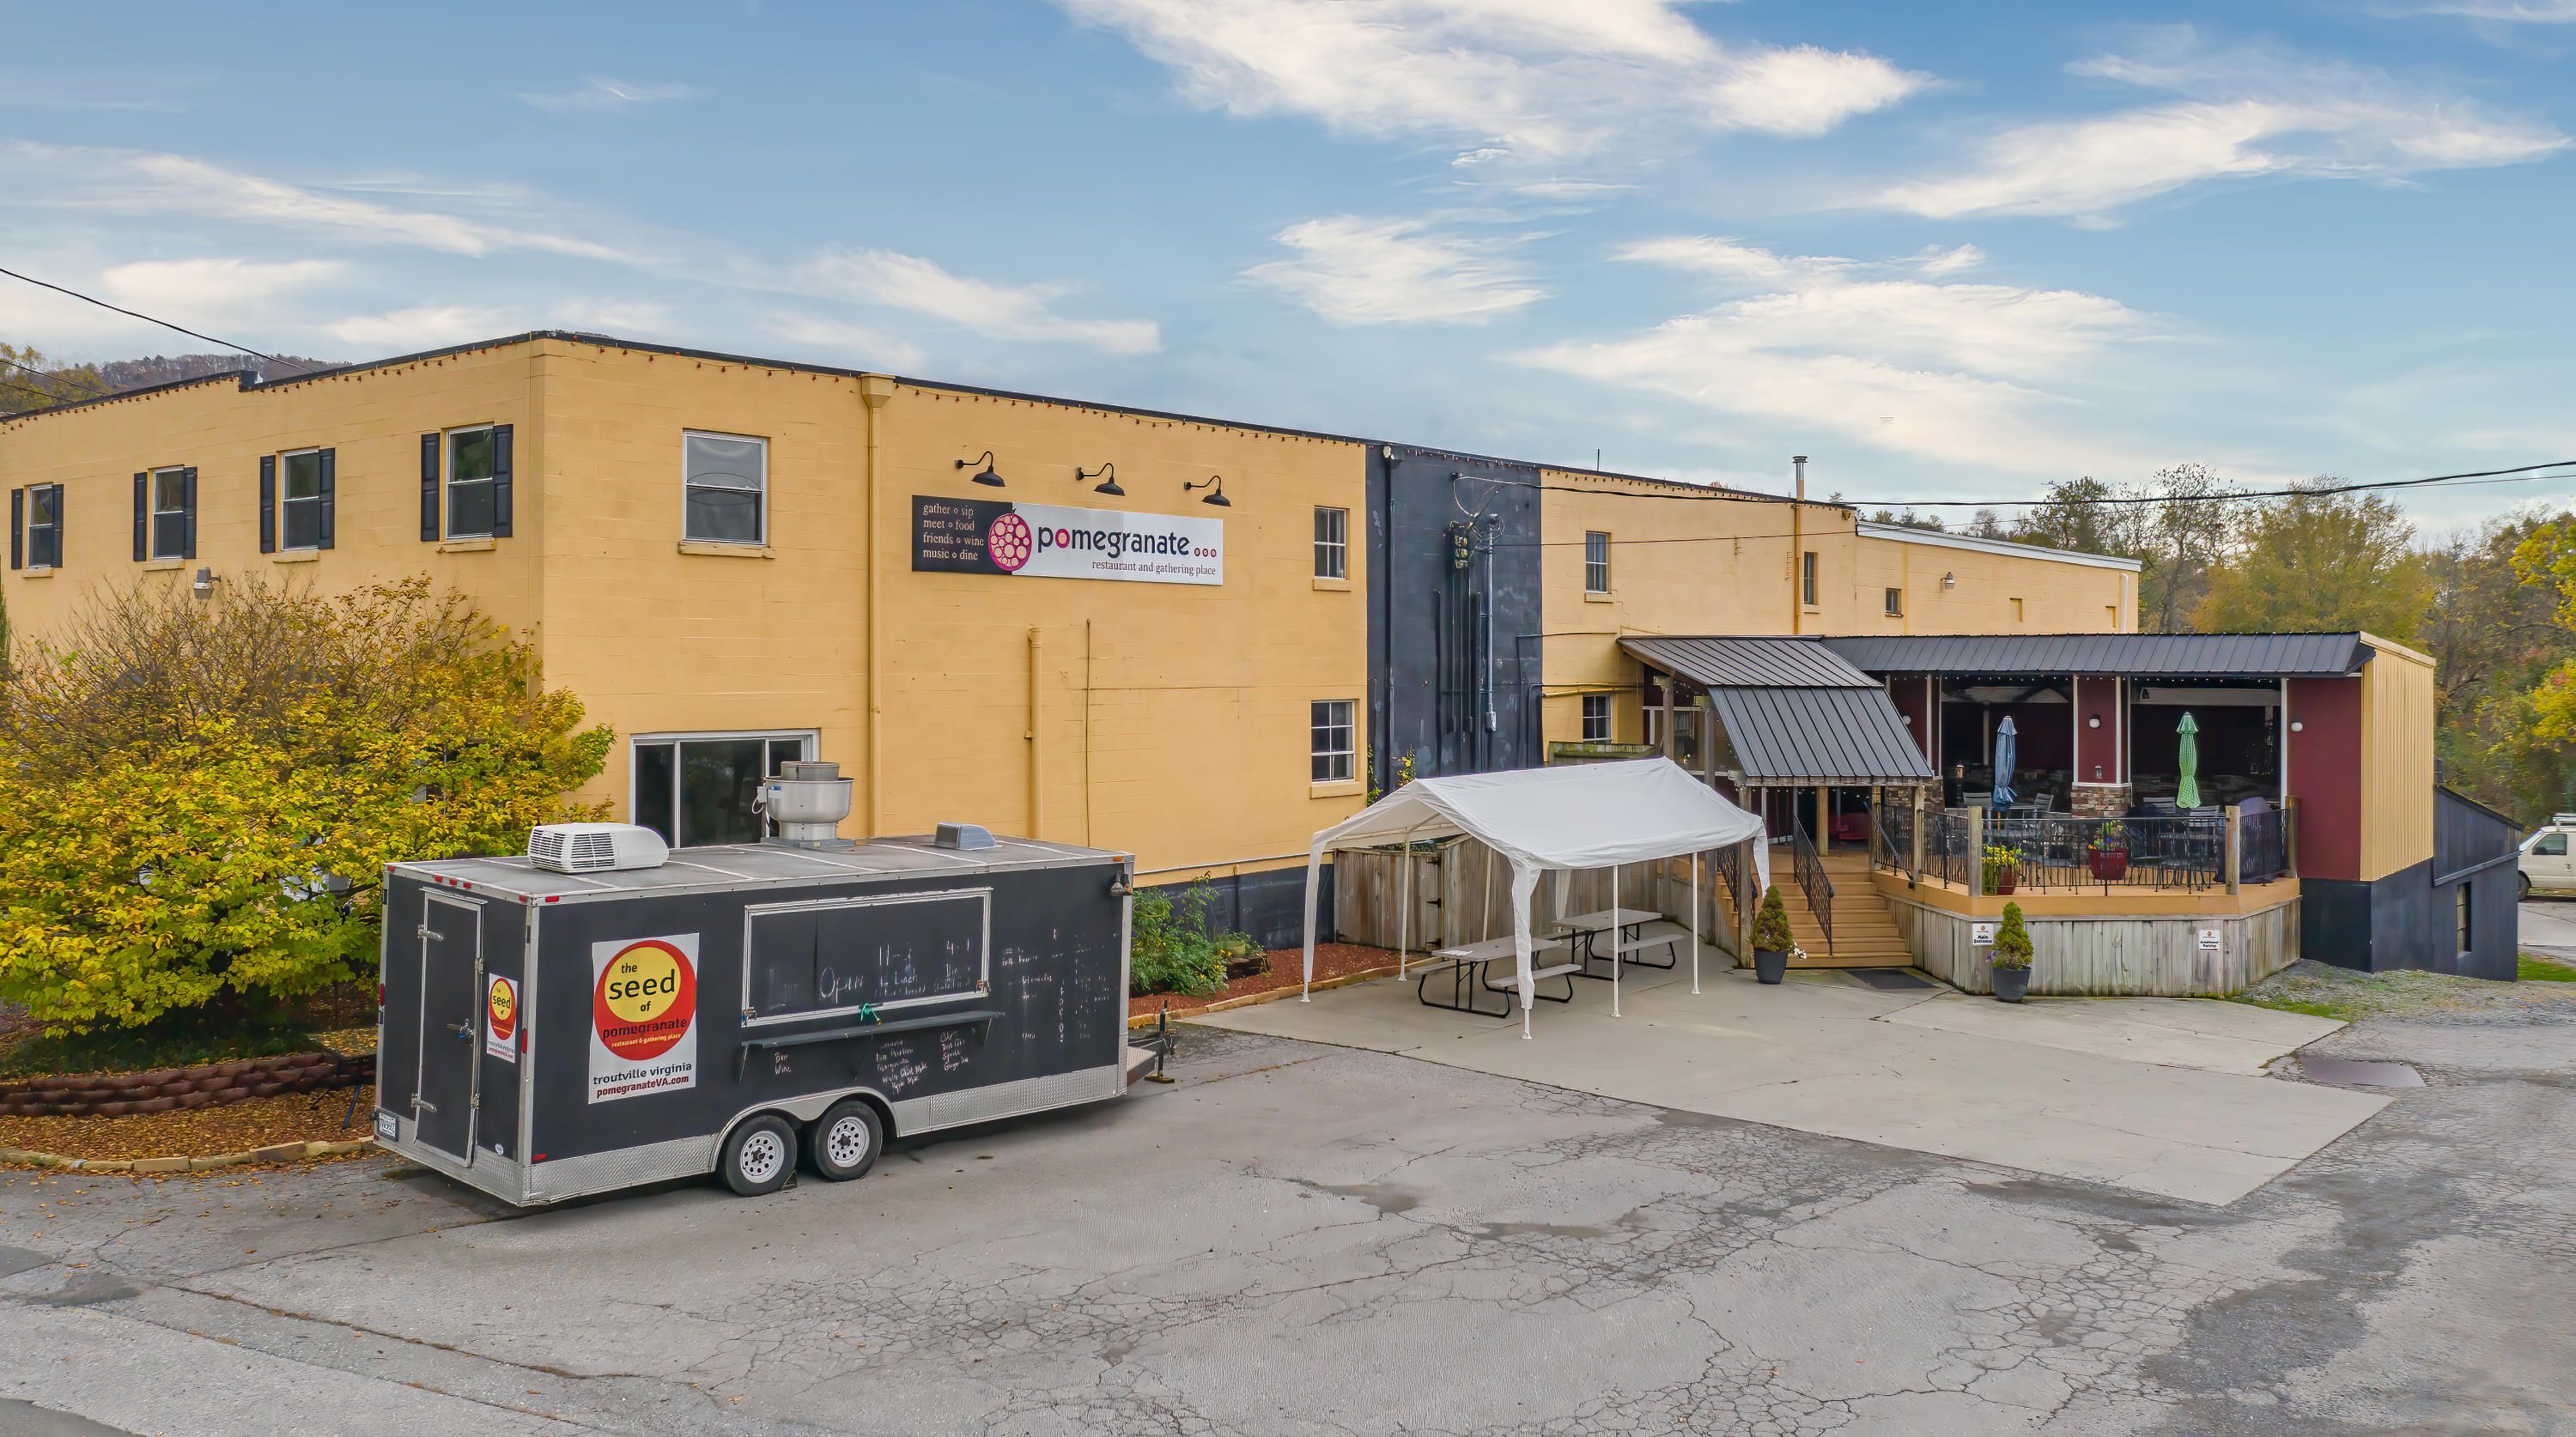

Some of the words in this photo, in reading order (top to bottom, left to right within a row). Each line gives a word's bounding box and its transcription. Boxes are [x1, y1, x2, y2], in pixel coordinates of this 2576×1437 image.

[923, 504, 951, 515] gather
[961, 506, 974, 518] sip
[923, 519, 945, 529] meet
[955, 519, 975, 531] food
[923, 532, 954, 544] friends
[963, 536, 984, 546] wine
[1037, 526, 1190, 559] pomegranate
[923, 549, 950, 559] music
[959, 549, 978, 561] dine
[1092, 561, 1137, 572] restaurant
[1138, 561, 1154, 573] and
[1156, 563, 1194, 576] gathering
[1195, 564, 1217, 577] place
[621, 962, 638, 974] the
[609, 968, 676, 1000] seed
[492, 995, 511, 1010] seed
[640, 1001, 651, 1012] of
[602, 1018, 688, 1041] pomegranate
[611, 1038, 638, 1048] restaurant
[643, 1034, 667, 1045] gathering
[668, 1033, 682, 1042] place
[592, 1067, 647, 1085] troutville
[649, 1062, 692, 1076] virginia
[597, 1075, 690, 1099] pomegranateVA.com
